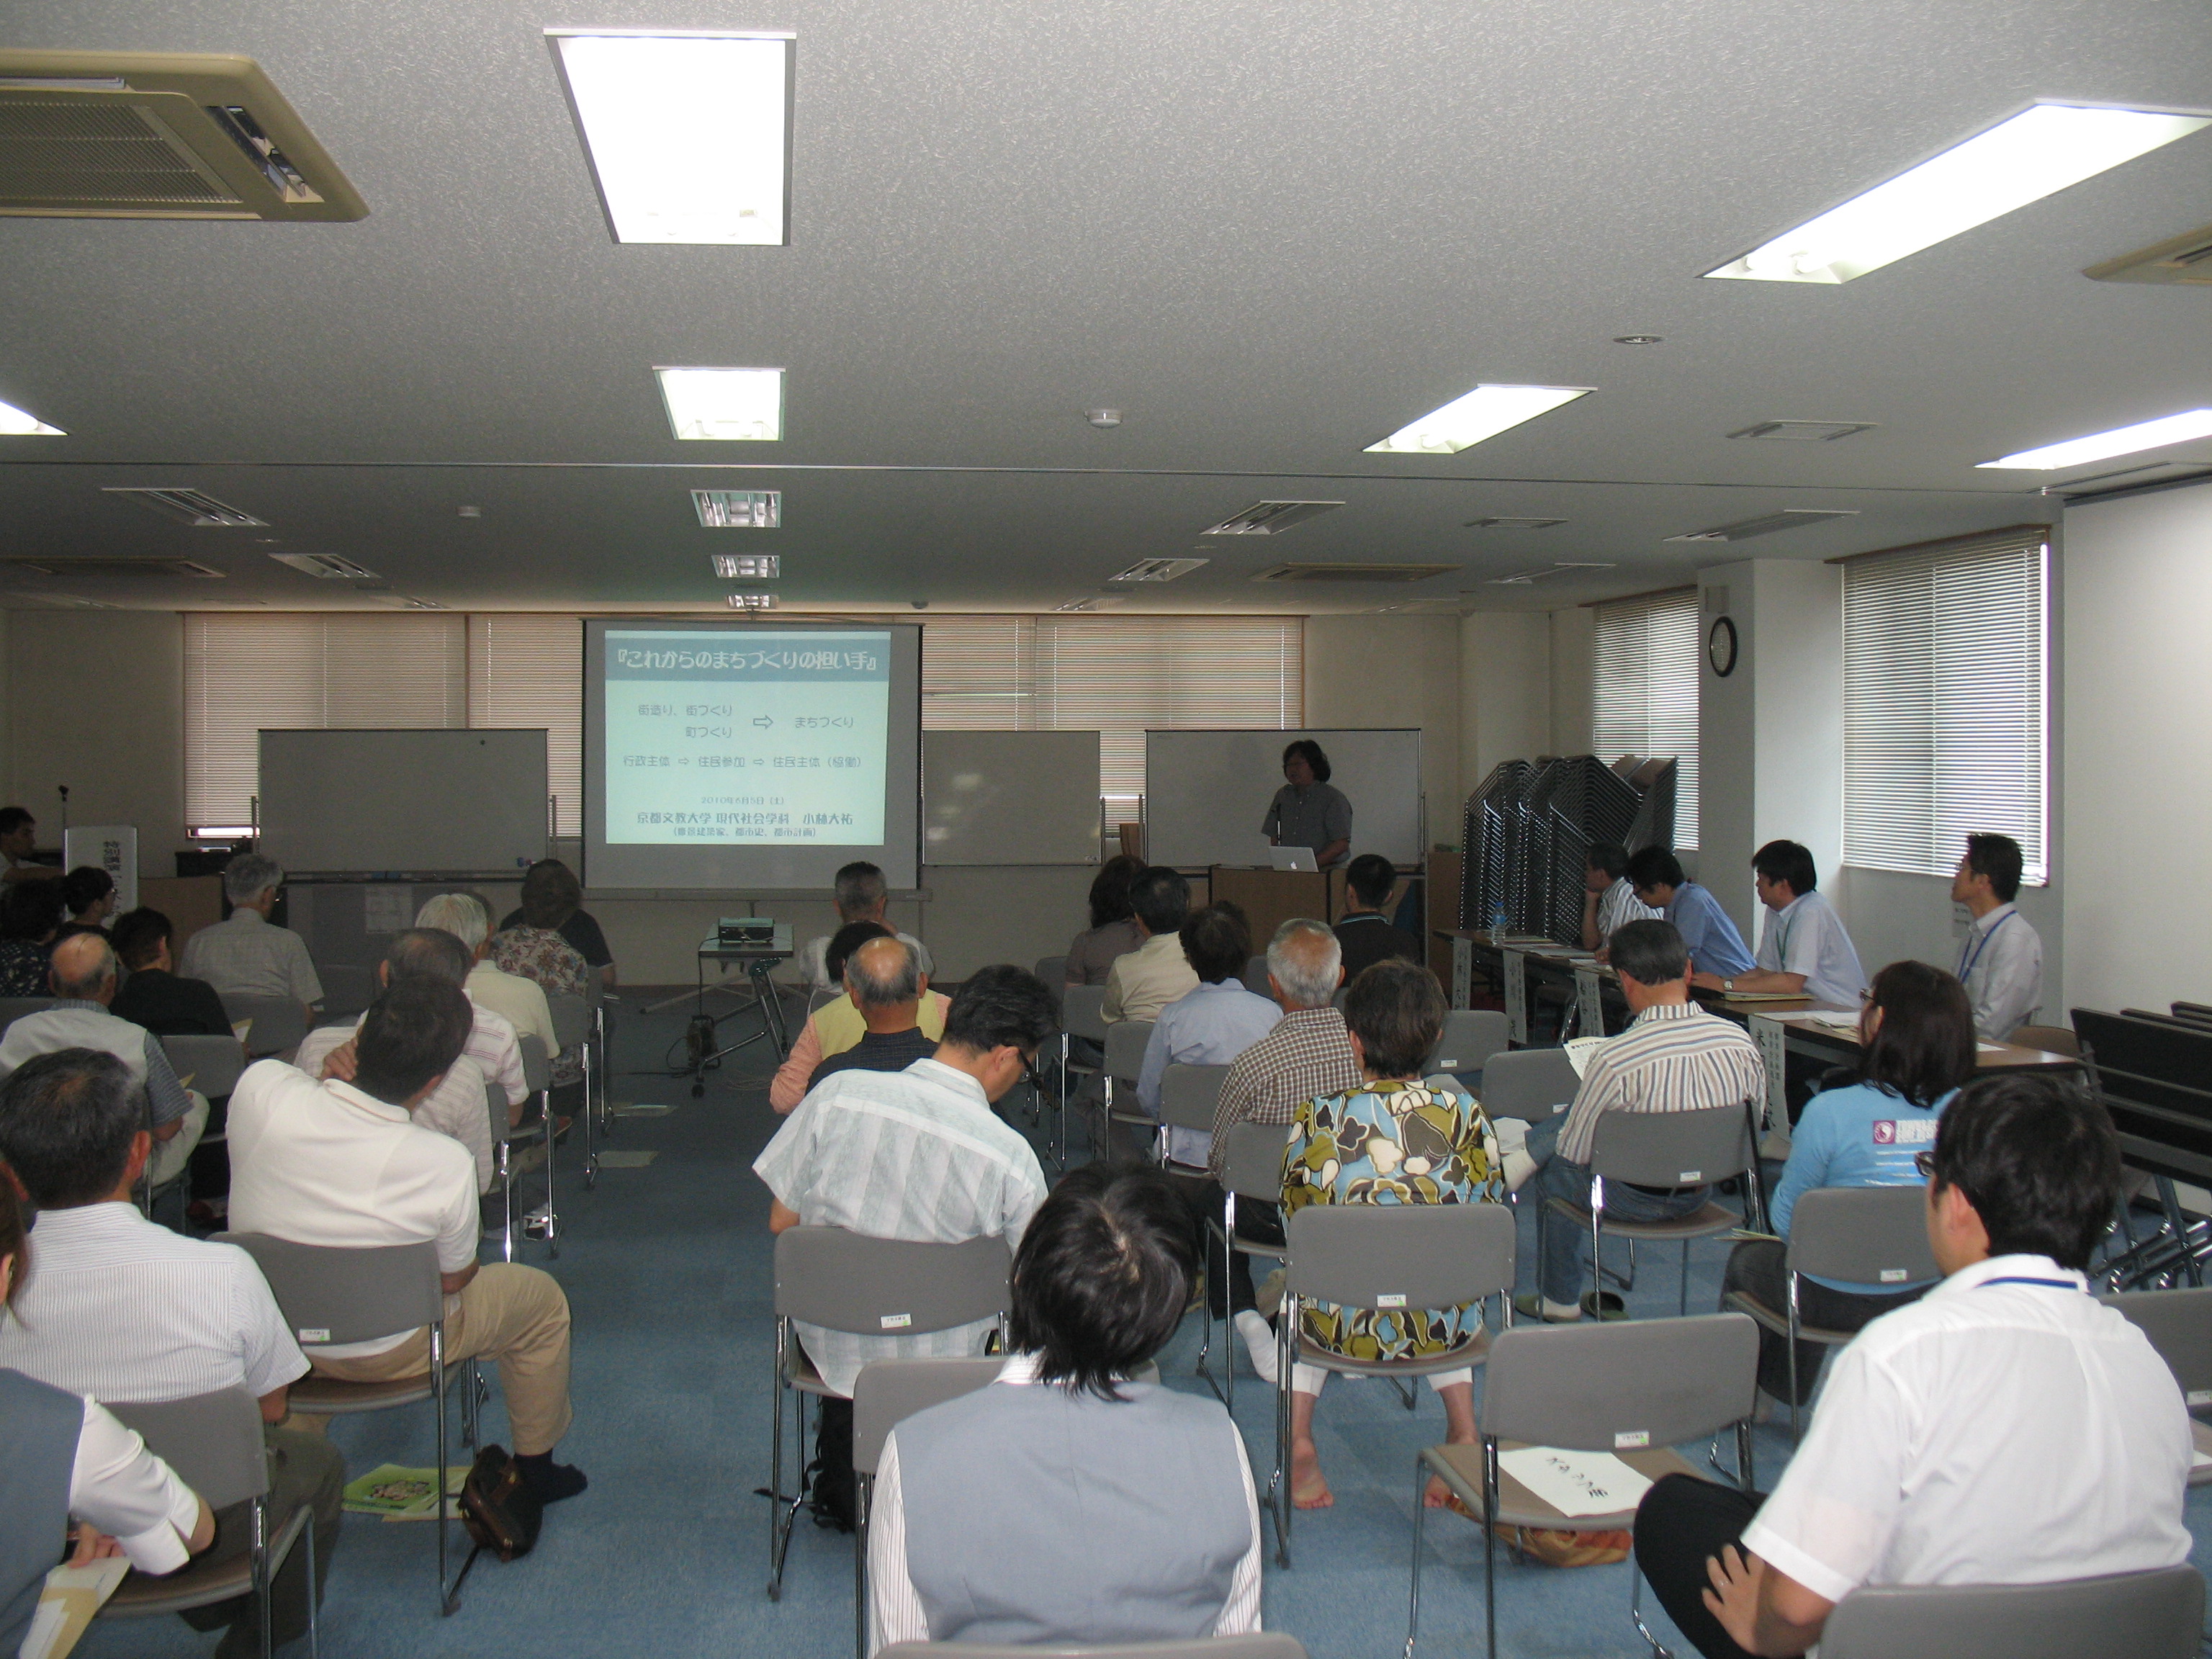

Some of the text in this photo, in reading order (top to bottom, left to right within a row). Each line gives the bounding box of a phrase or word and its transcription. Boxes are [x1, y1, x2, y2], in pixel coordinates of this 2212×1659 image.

[617, 649, 876, 671] 『これからのまちづくりの担い手』
[623, 755, 670, 768] 行政主体
[698, 755, 745, 768] 住民参加
[637, 811, 711, 825] 京都文教大学
[716, 812, 790, 826] 現代社会学科
